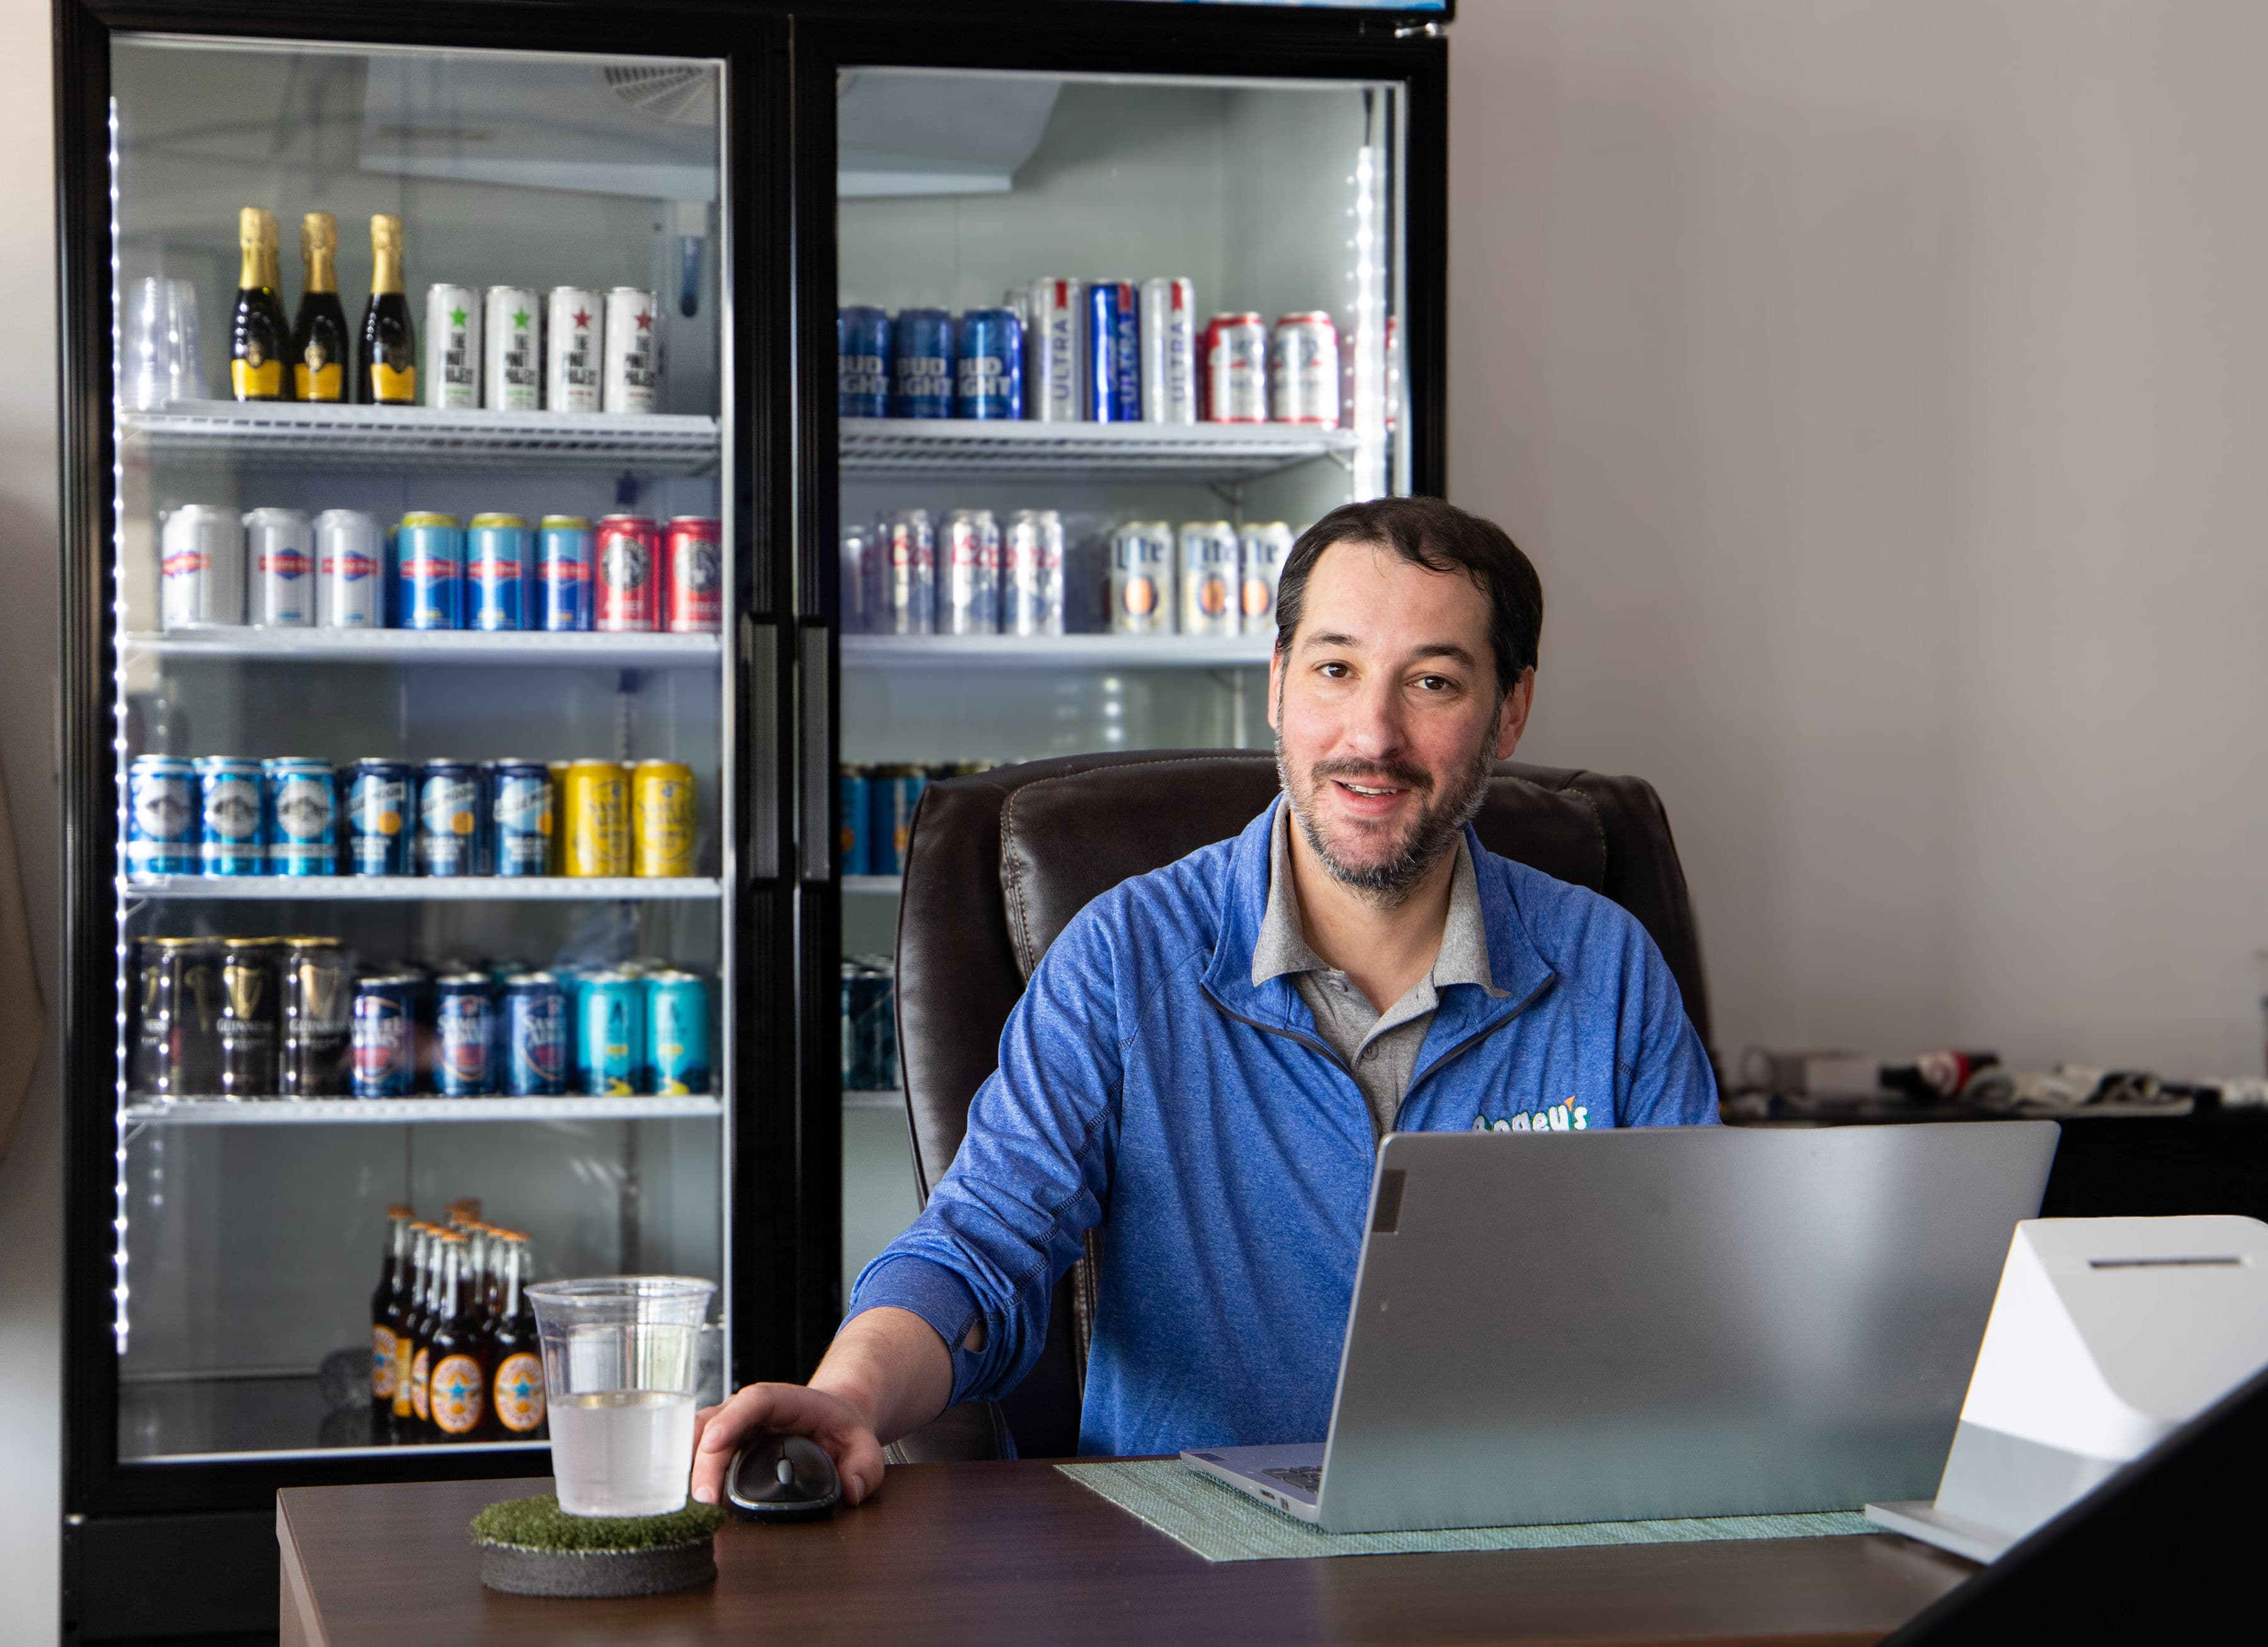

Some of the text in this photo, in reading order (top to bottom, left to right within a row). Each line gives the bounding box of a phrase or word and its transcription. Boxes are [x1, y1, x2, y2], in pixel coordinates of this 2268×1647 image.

[1053, 319, 1070, 401] ULTRA
[1118, 320, 1136, 403] ULTRA
[1170, 322, 1186, 402] ULTRA
